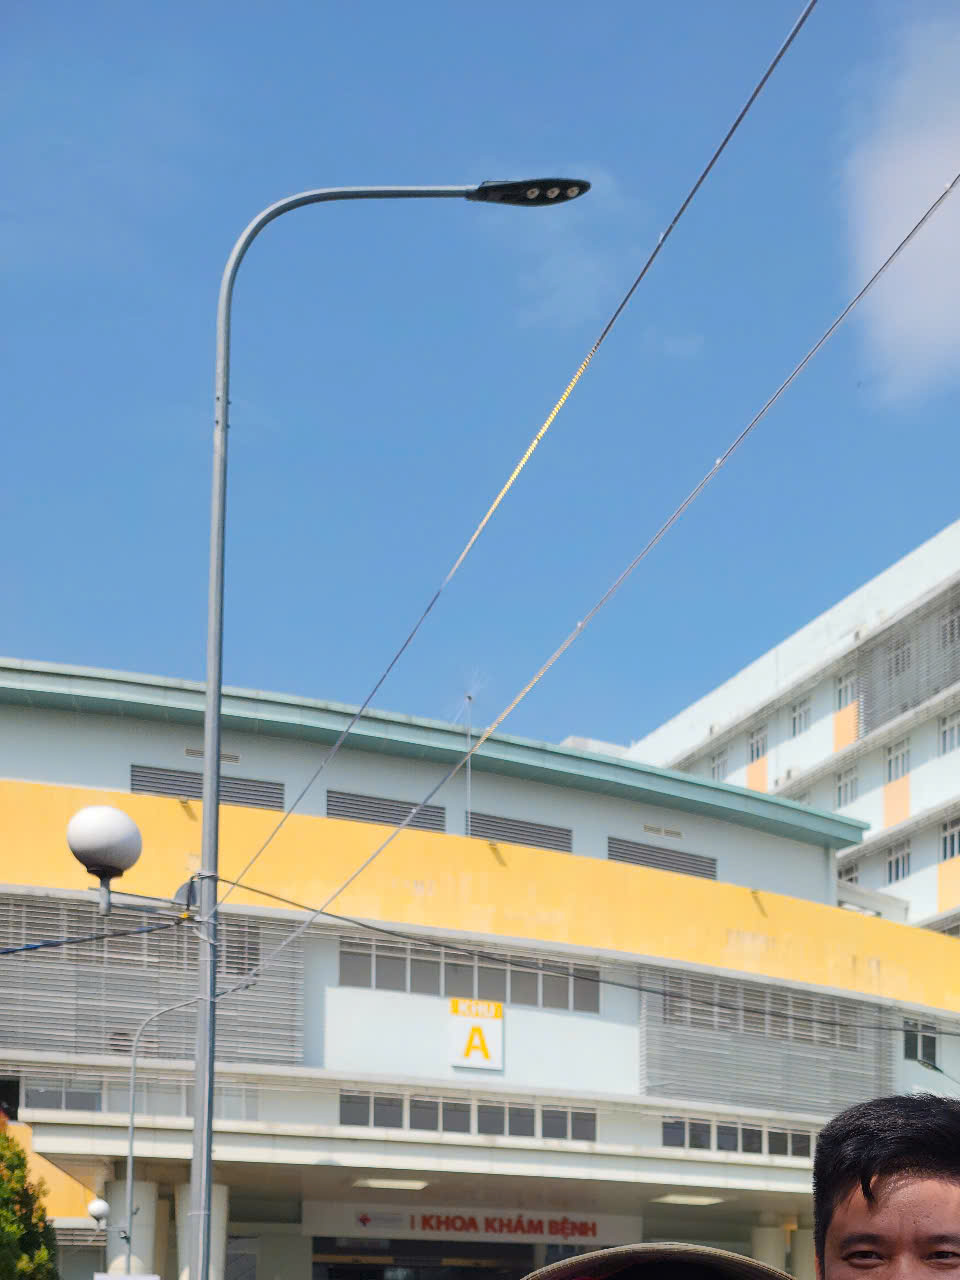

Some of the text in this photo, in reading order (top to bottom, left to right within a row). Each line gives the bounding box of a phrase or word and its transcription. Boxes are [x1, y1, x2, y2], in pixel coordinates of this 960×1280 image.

[464, 1026, 490, 1059] A
[421, 1214, 479, 1232] KHOA
[484, 1214, 544, 1235] KHÁM
[548, 1216, 597, 1240] BỆNH
